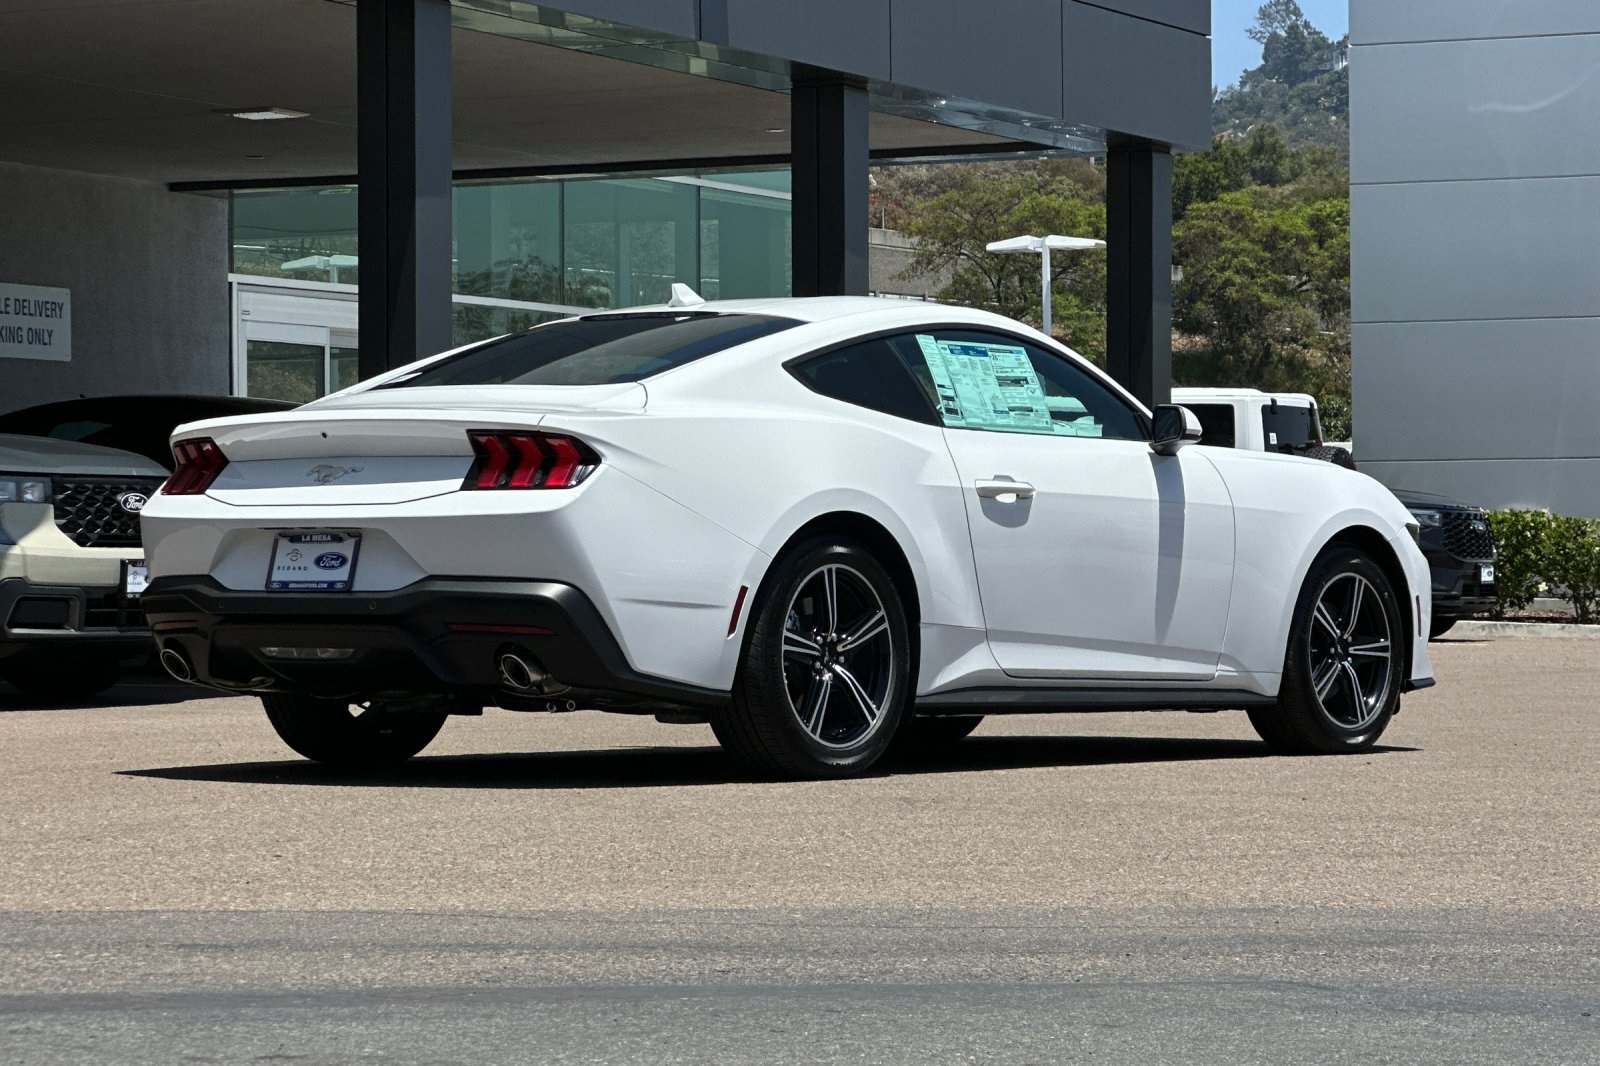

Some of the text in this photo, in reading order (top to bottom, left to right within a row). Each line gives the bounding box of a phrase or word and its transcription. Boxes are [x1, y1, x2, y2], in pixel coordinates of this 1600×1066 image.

[14, 298, 64, 319] DELIVERY
[28, 327, 54, 346] ONLY
[126, 496, 144, 508] Ford
